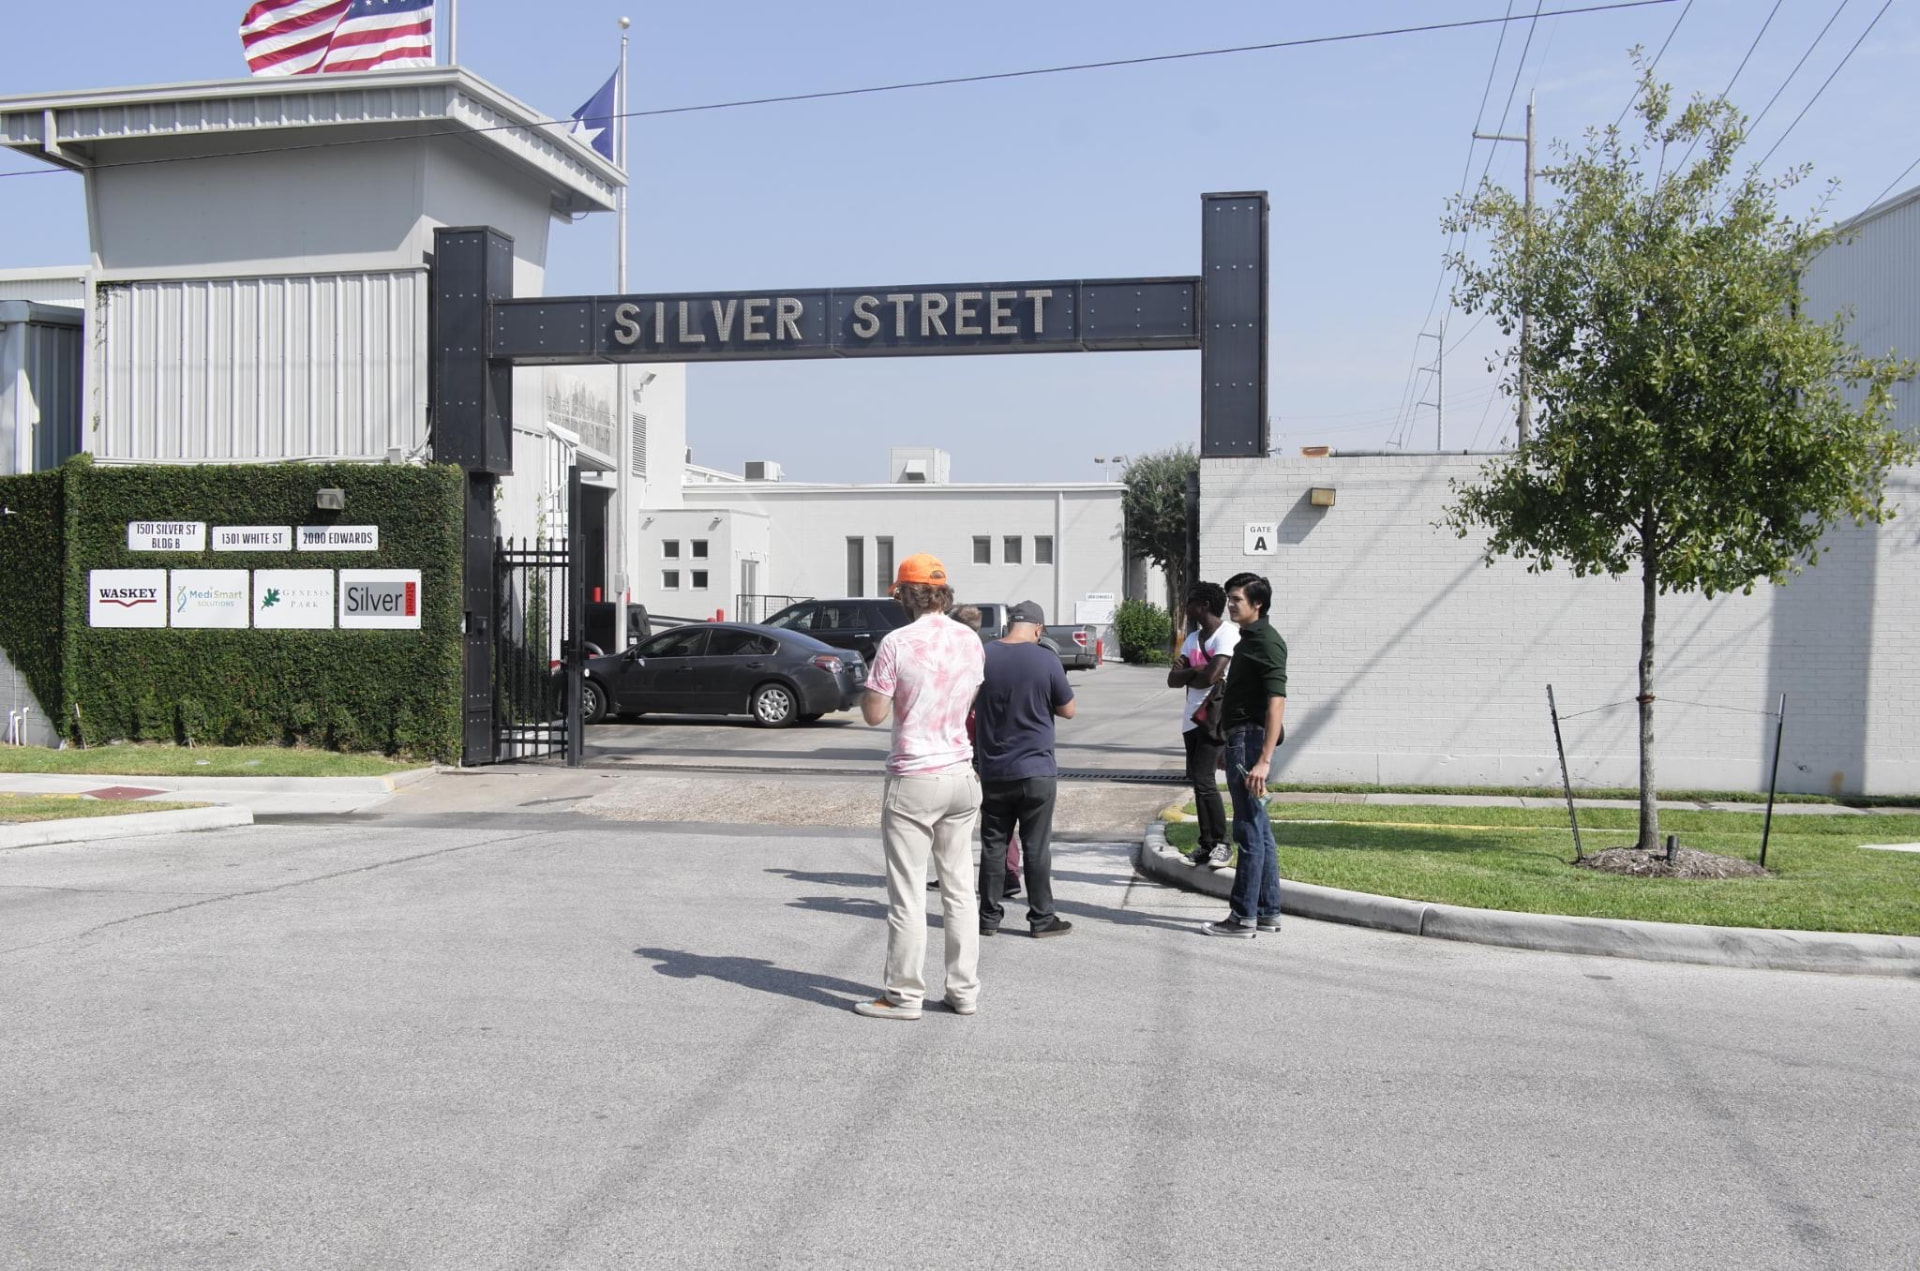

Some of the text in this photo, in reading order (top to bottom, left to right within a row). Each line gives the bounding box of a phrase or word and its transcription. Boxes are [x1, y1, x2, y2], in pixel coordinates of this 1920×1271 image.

[614, 289, 1053, 345] SILVER STREET
[136, 523, 197, 536] 1501 SILVER ST
[151, 537, 181, 549] BLDG B
[222, 532, 283, 544] 1301 WHITE ST
[303, 532, 373, 544] 2000 EDWARDS
[1254, 536, 1267, 551] A
[99, 588, 157, 598] WASKEY
[347, 586, 403, 612] Silver
[405, 583, 415, 615] Street
